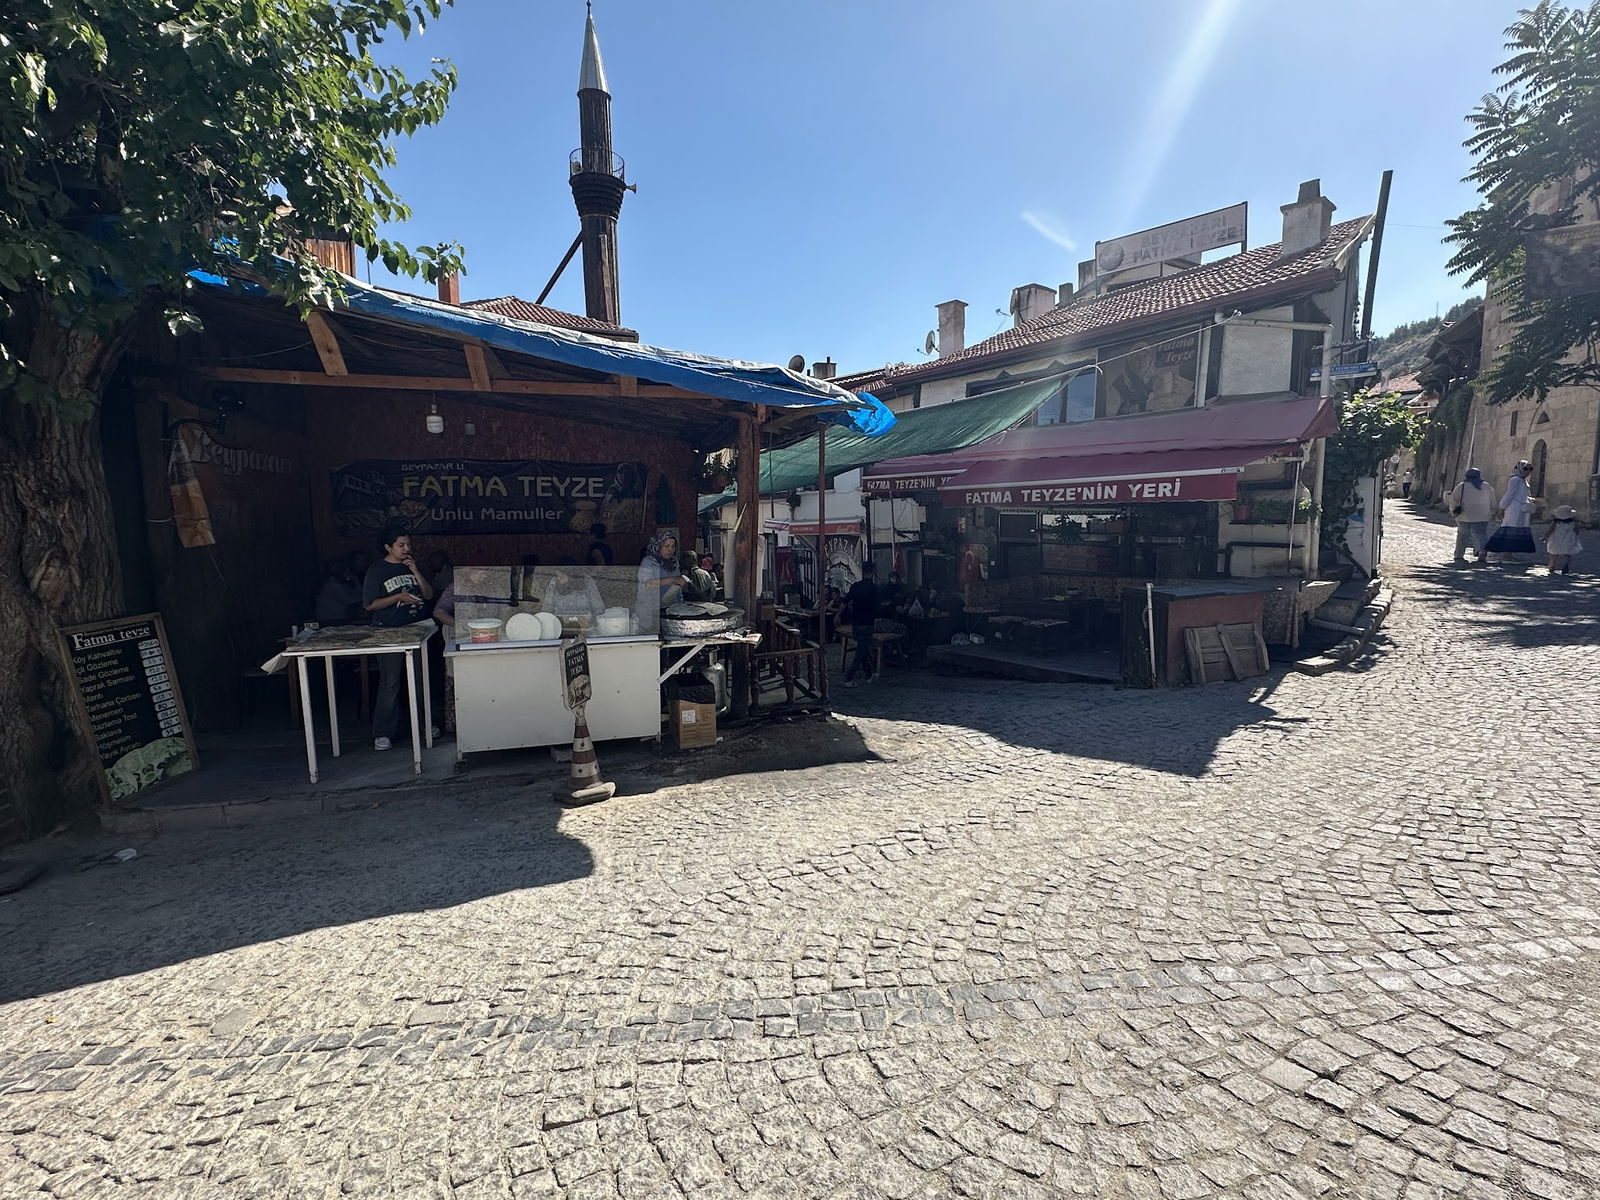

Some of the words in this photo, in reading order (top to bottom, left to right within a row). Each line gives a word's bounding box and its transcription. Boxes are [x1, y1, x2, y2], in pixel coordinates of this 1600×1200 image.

[402, 475, 508, 498] FATMA
[517, 476, 607, 498] TEYZE
[866, 480, 890, 491] FATMA
[895, 475, 936, 490] TEYZE'NİN
[964, 490, 1013, 505] FATMA
[1021, 482, 1119, 503] TEYZE'NİN
[1127, 477, 1182, 499] YERİ
[431, 507, 474, 521] Unlu
[480, 507, 564, 521] Mamuller
[383, 574, 418, 593] HOUST
[72, 632, 116, 649] Fatma
